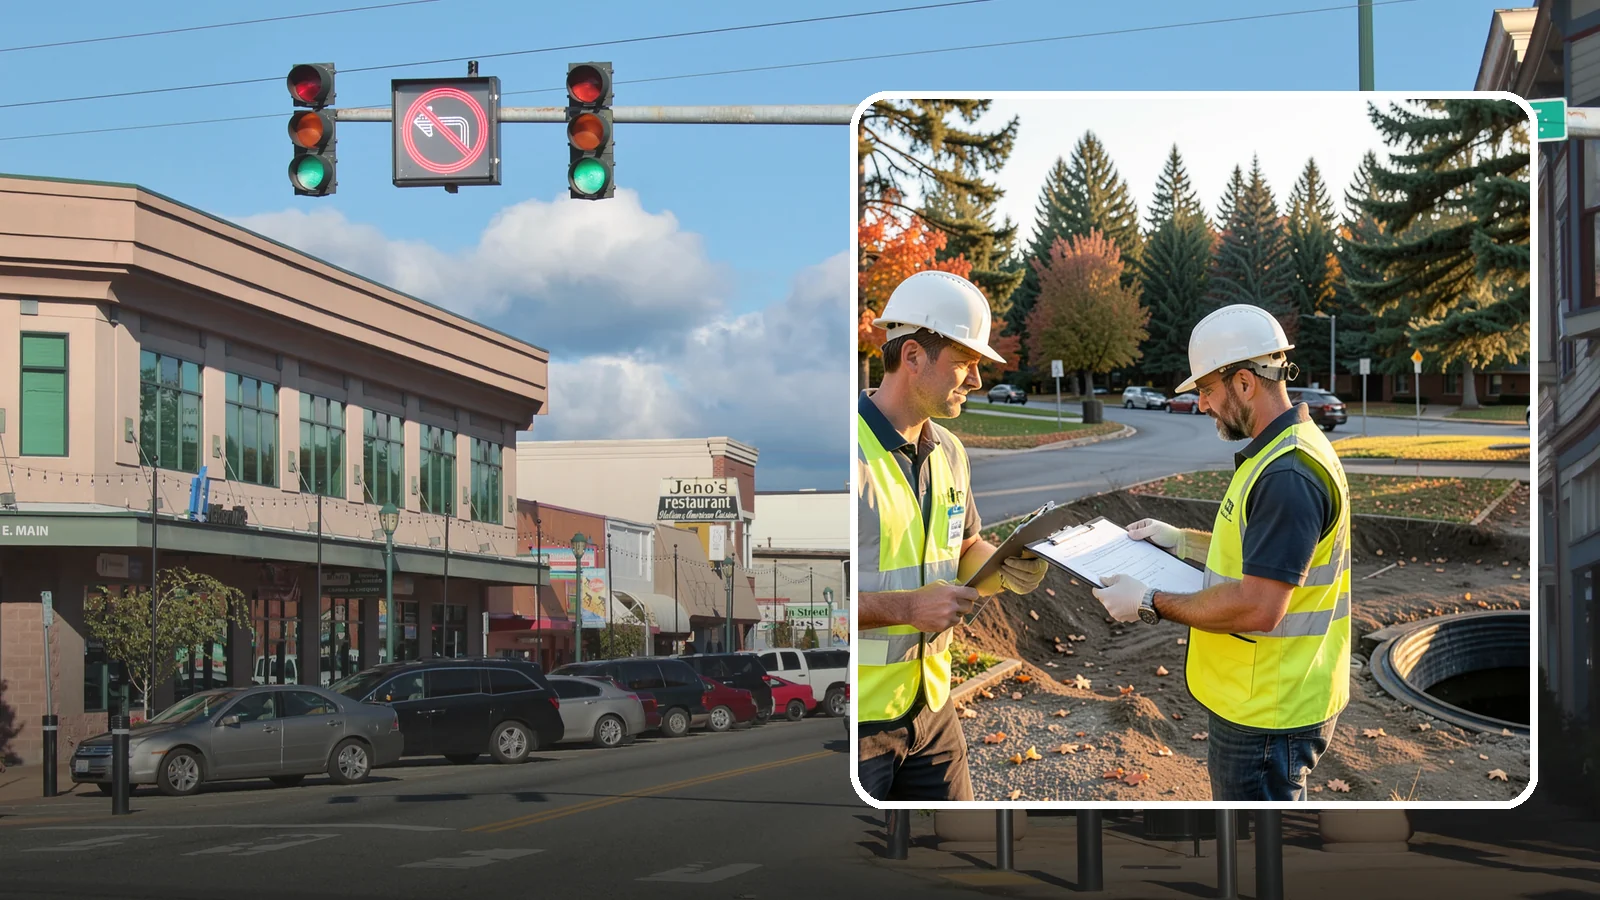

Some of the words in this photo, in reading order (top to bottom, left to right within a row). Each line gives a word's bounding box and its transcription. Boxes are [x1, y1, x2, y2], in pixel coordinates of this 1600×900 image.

[669, 480, 728, 495] Jeno's
[665, 496, 731, 509] restaurant
[658, 510, 681, 519] Italian
[686, 510, 715, 519] American
[715, 510, 738, 519] Cuisine
[2, 525, 13, 536] E.
[15, 525, 49, 536] MAIN
[797, 608, 829, 617] Street
